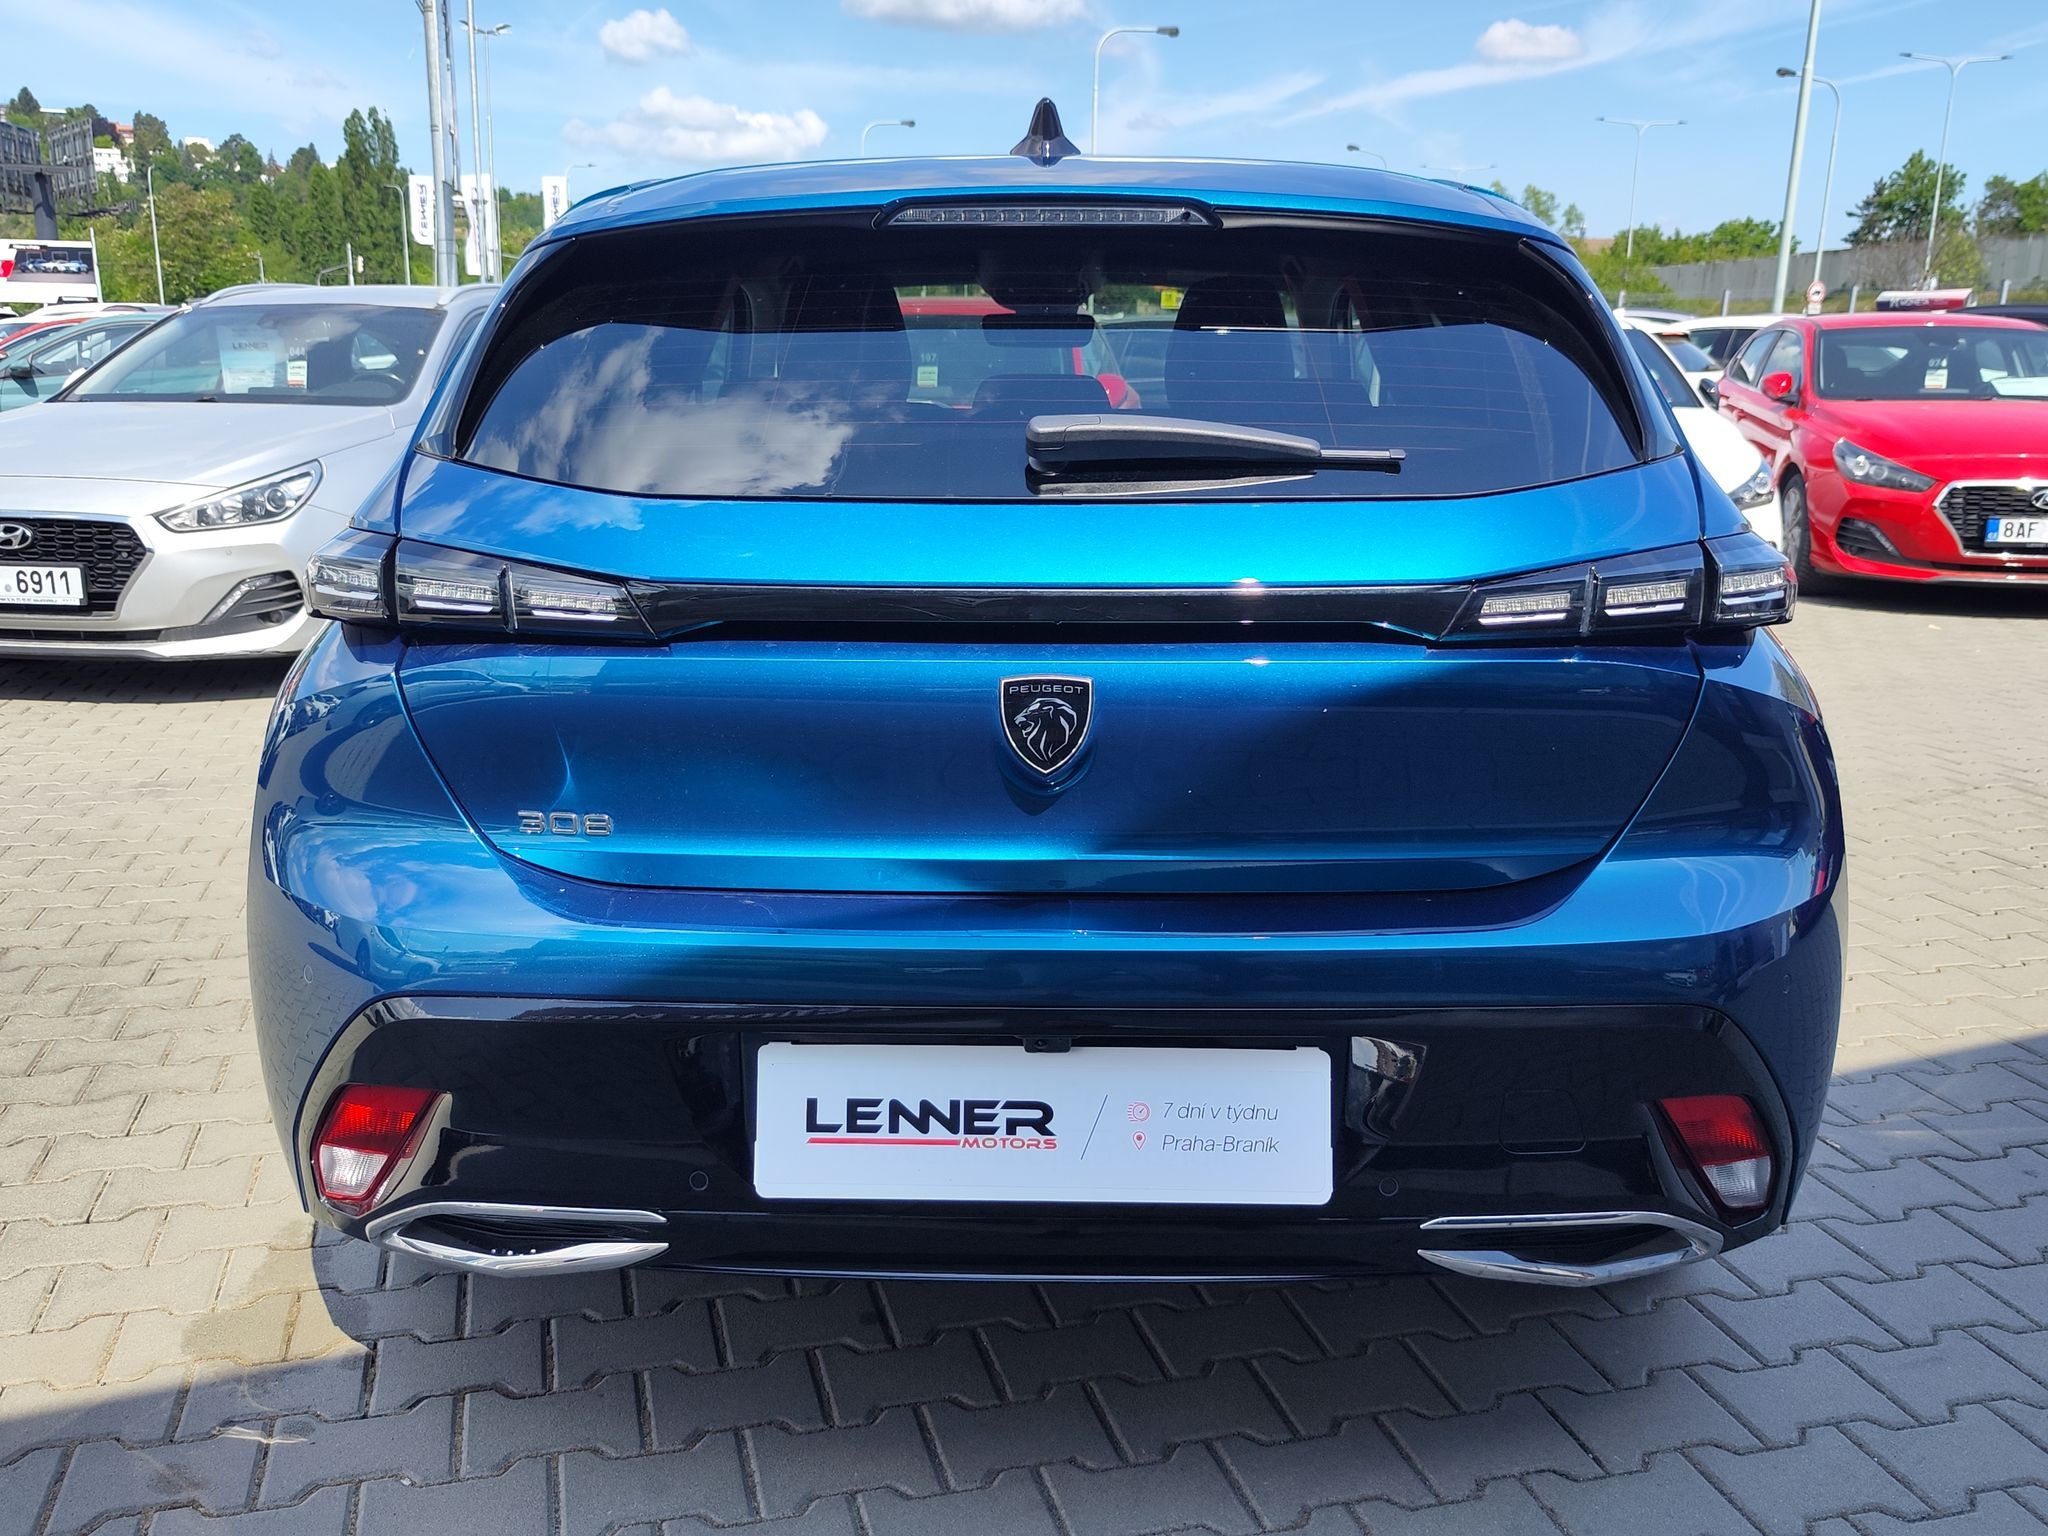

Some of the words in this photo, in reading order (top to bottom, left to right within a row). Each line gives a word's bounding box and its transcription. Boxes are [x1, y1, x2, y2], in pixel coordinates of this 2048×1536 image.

[2003, 521, 2039, 538] 8AF
[16, 569, 71, 595] 6911
[1009, 684, 1084, 695] PEUGEOT
[517, 809, 613, 836] 308
[806, 1097, 1057, 1136] LENNER
[1163, 1101, 1174, 1119] 7
[1177, 1102, 1207, 1120] dní
[1210, 1106, 1222, 1120] v
[1226, 1103, 1279, 1124] týdnu
[961, 1136, 1058, 1150] MOTORS
[1162, 1134, 1280, 1153] Praha-Braník
